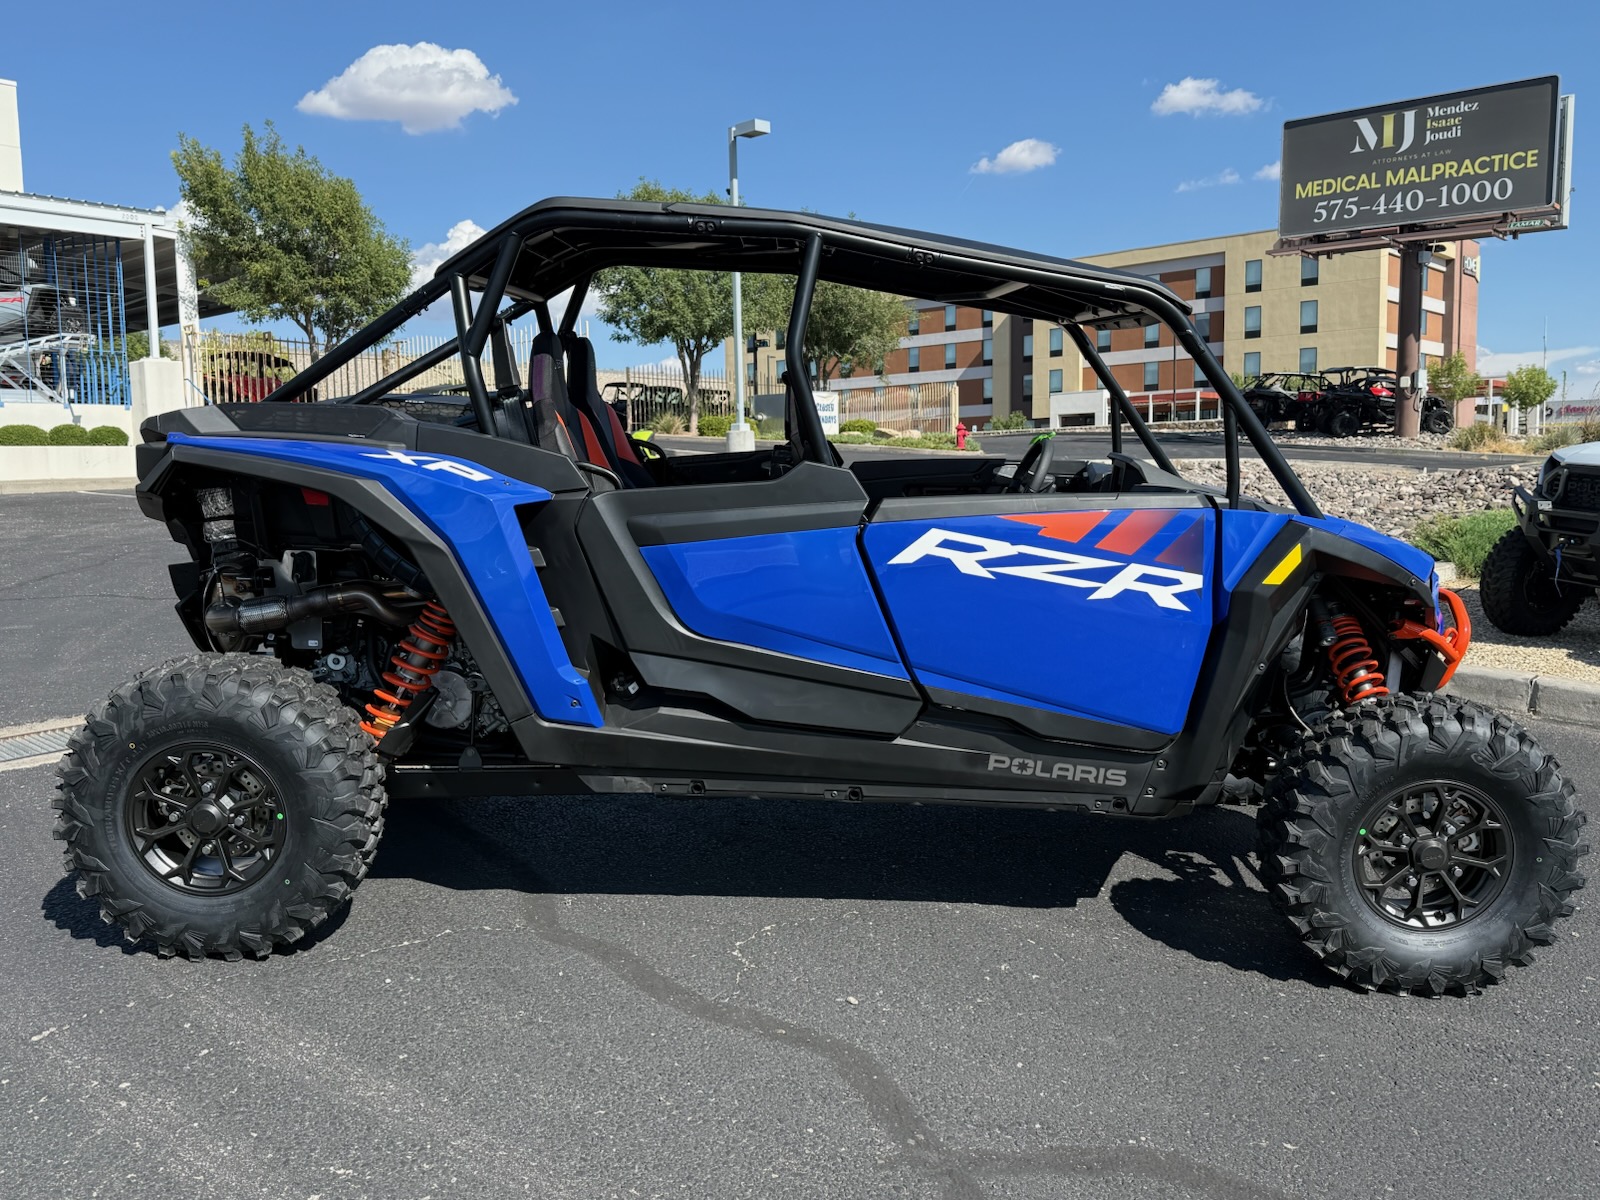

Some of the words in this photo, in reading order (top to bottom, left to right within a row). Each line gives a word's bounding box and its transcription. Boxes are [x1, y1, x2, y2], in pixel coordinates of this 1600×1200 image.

[1426, 116, 1462, 129] Isaac
[1427, 101, 1479, 118] Mendez
[1424, 126, 1461, 146] Joudi
[1295, 172, 1381, 200] MEDICAL
[1386, 149, 1539, 187] MALPRACTICE
[1372, 154, 1418, 165] ATTORNEYS
[1313, 177, 1513, 223] 575-440-1000
[358, 449, 494, 482] XP
[887, 527, 1203, 612] RZR
[987, 754, 1127, 787] POLARIS
